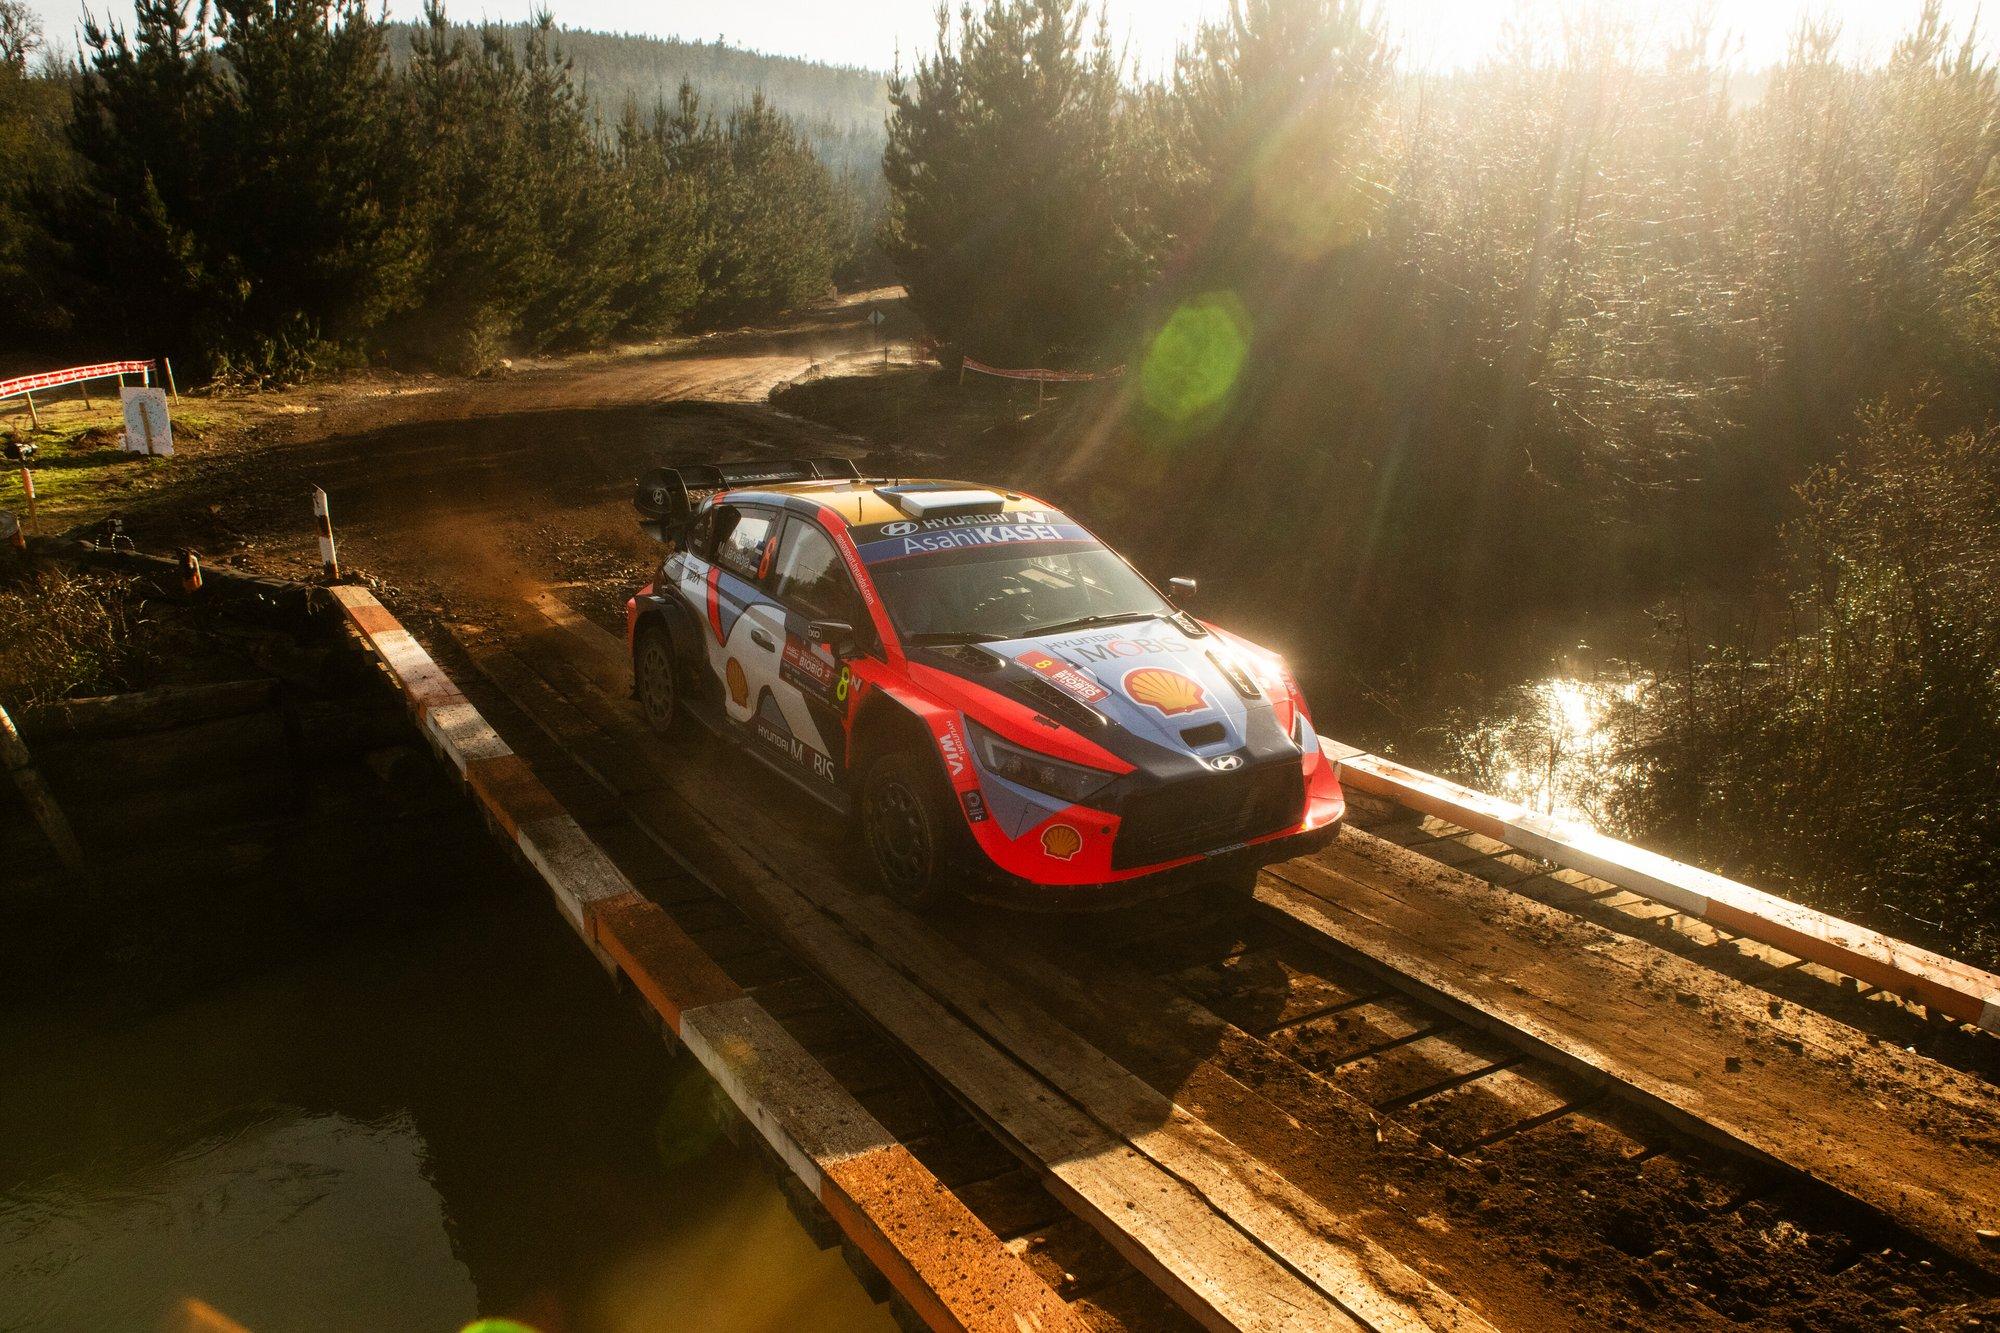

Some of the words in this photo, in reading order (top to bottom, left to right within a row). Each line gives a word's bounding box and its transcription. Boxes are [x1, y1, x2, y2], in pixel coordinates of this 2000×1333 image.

[923, 511, 1009, 529] HYUNDAI
[904, 525, 1063, 555] AsahiKASEI
[758, 534, 777, 580] 8
[836, 533, 874, 605] motorsport.hyundai.com
[1046, 633, 1124, 650] HYUNDAI
[1074, 636, 1190, 663] MOBIS
[1034, 660, 1053, 669] 8
[836, 666, 850, 701] 8
[758, 725, 789, 752] HYUNDAI
[947, 719, 966, 755] HYUNDAI
